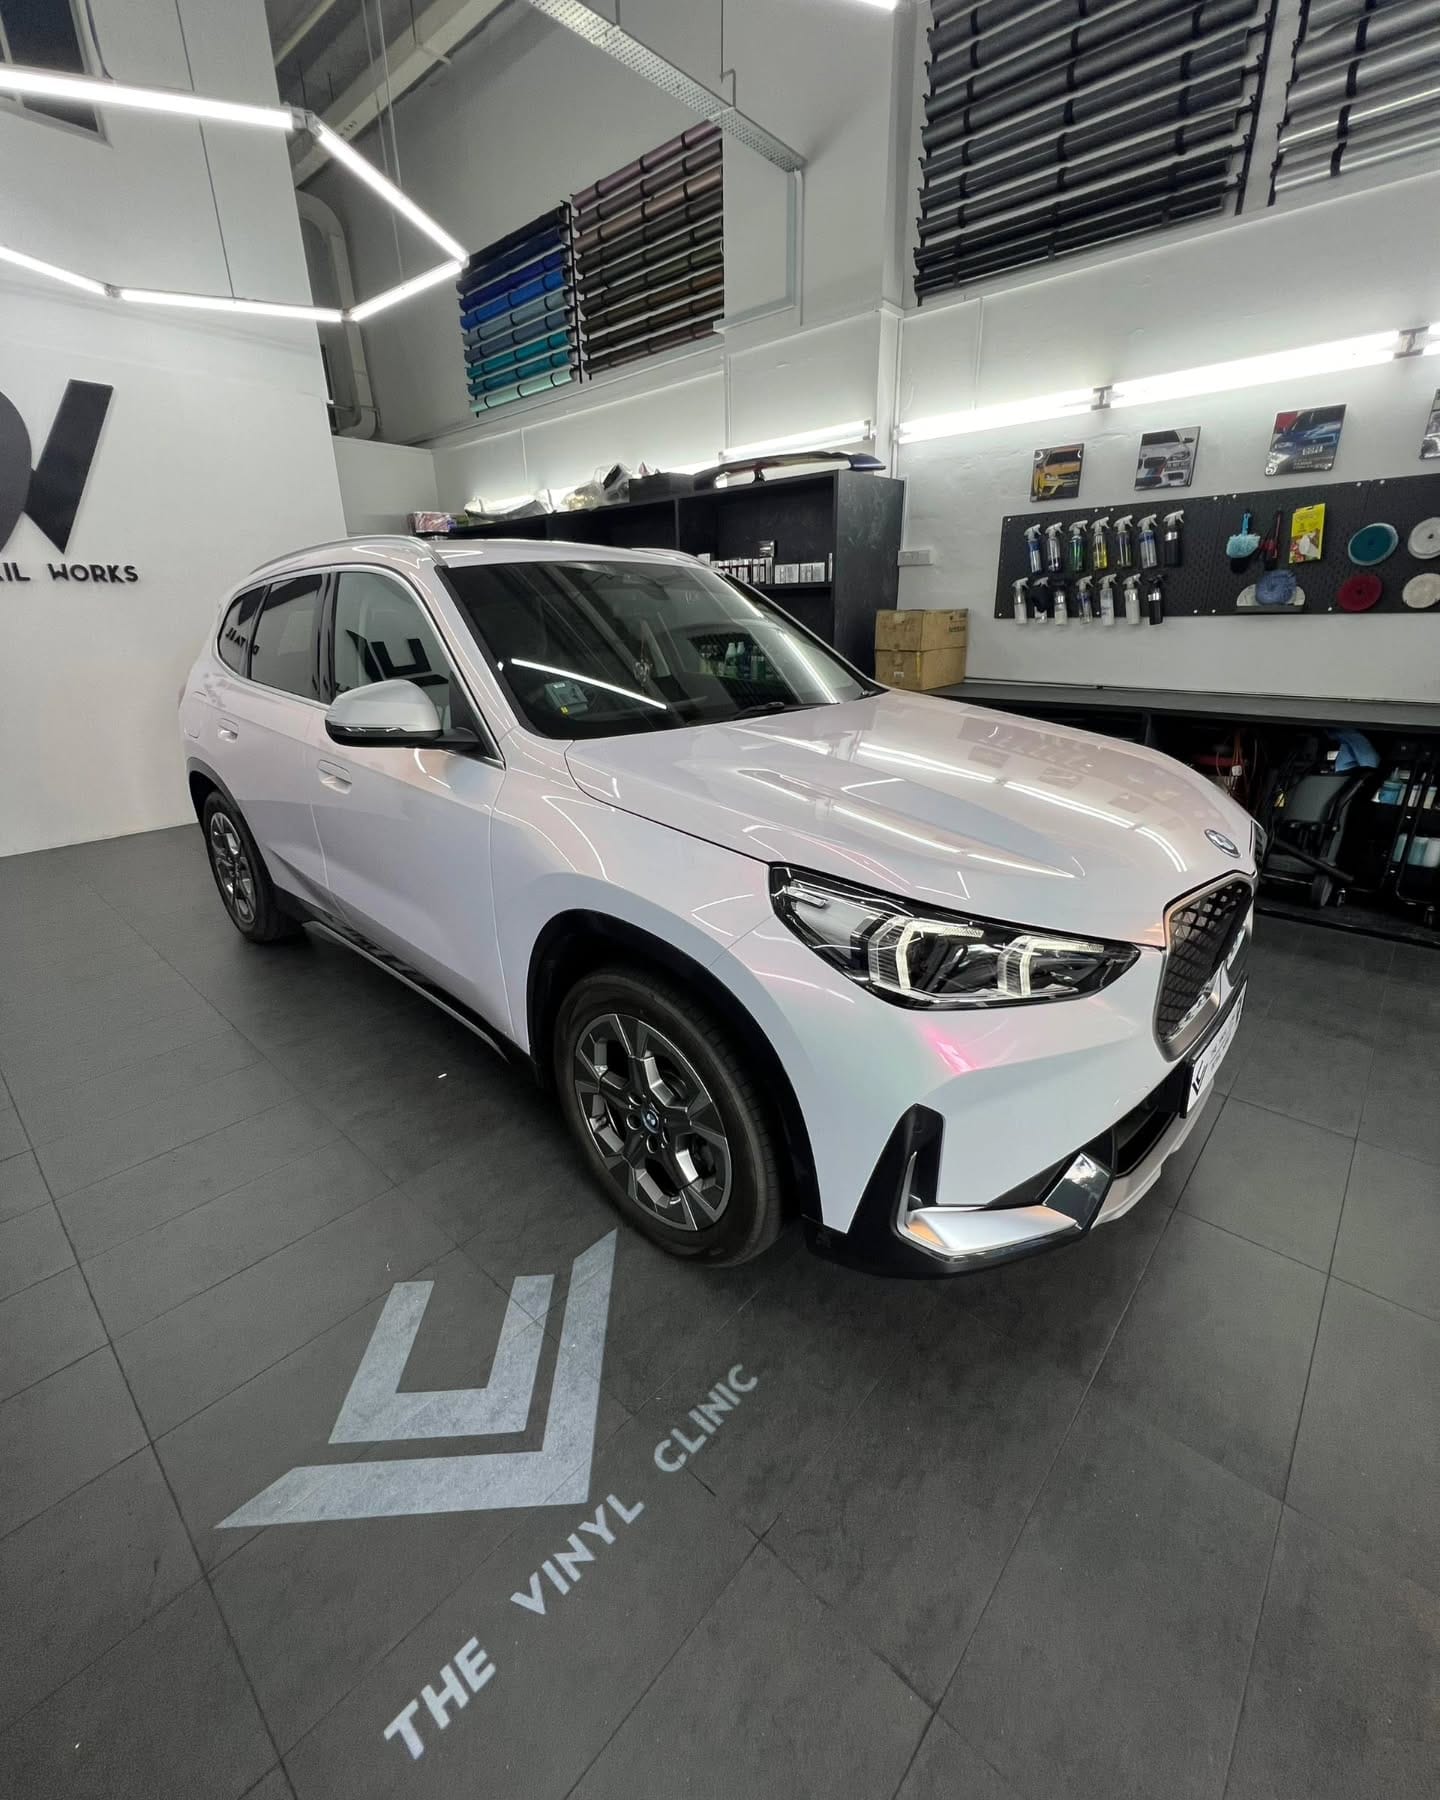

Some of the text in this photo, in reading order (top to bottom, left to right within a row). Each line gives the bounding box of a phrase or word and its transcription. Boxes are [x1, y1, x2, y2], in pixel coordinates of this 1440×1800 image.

[48, 563, 139, 583] WORKS
[383, 1363, 758, 1760] THE VINYL CLINIC
